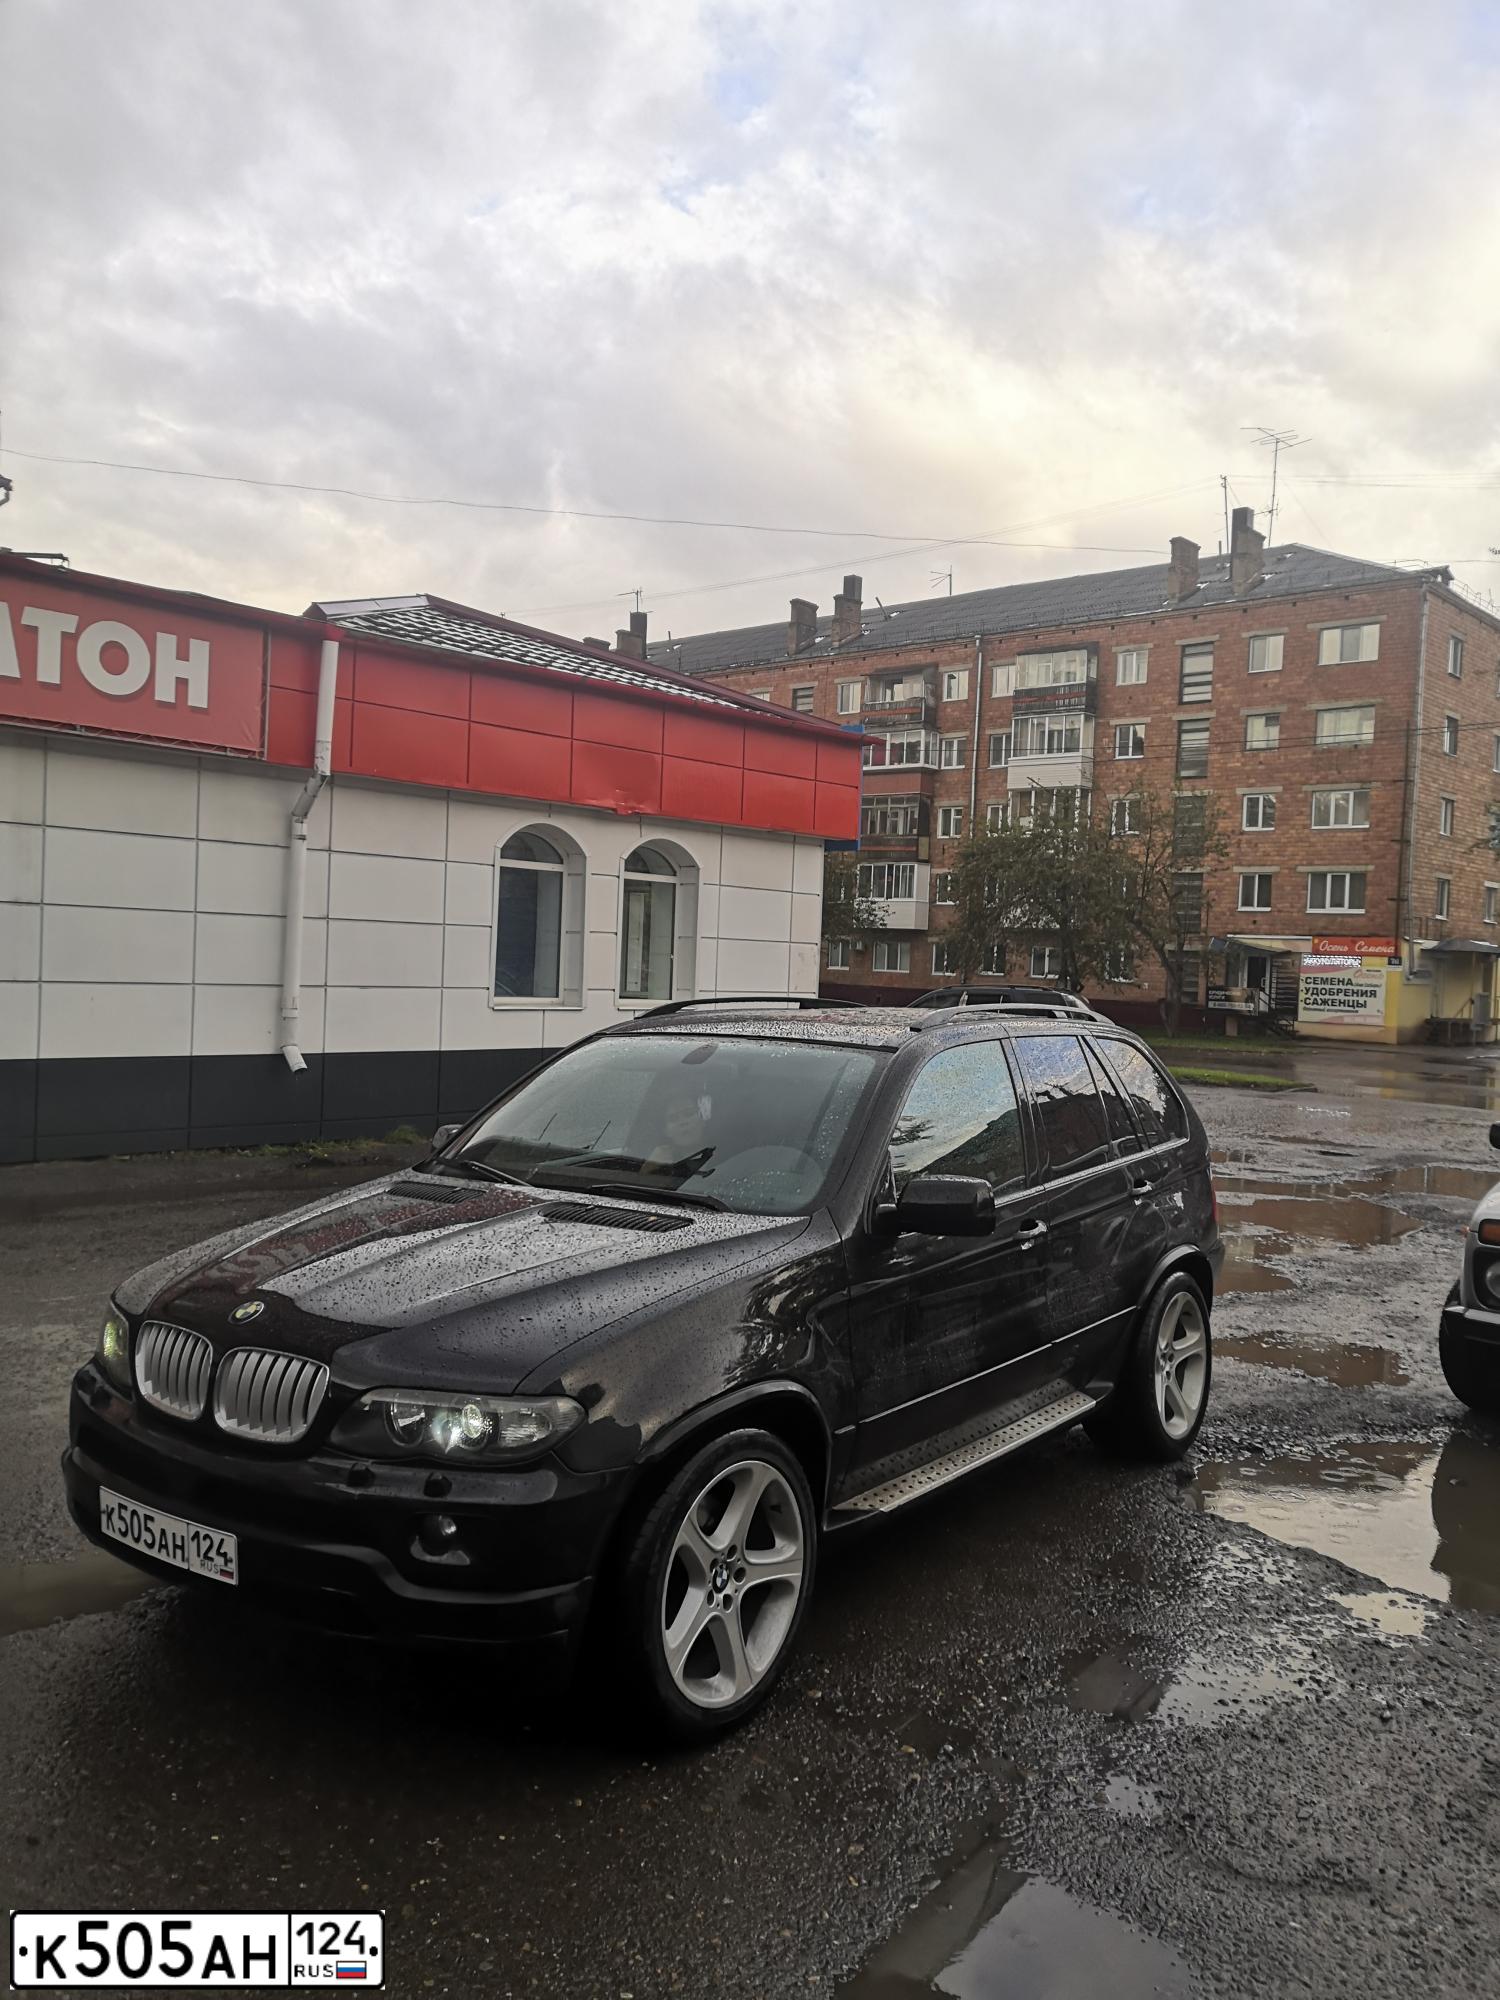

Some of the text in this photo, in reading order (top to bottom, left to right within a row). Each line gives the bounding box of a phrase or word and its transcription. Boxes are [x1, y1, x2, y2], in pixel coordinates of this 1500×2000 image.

[1319, 940, 1395, 954] Осень Семена
[1304, 976, 1354, 987] СЕМЕНА
[1304, 987, 1377, 998] УДОБРЕНИЯ
[1303, 997, 1367, 1009] САЖЕНЦЫ
[105, 1502, 229, 1567] К505АН 124
[200, 1559, 219, 1575] RUS
